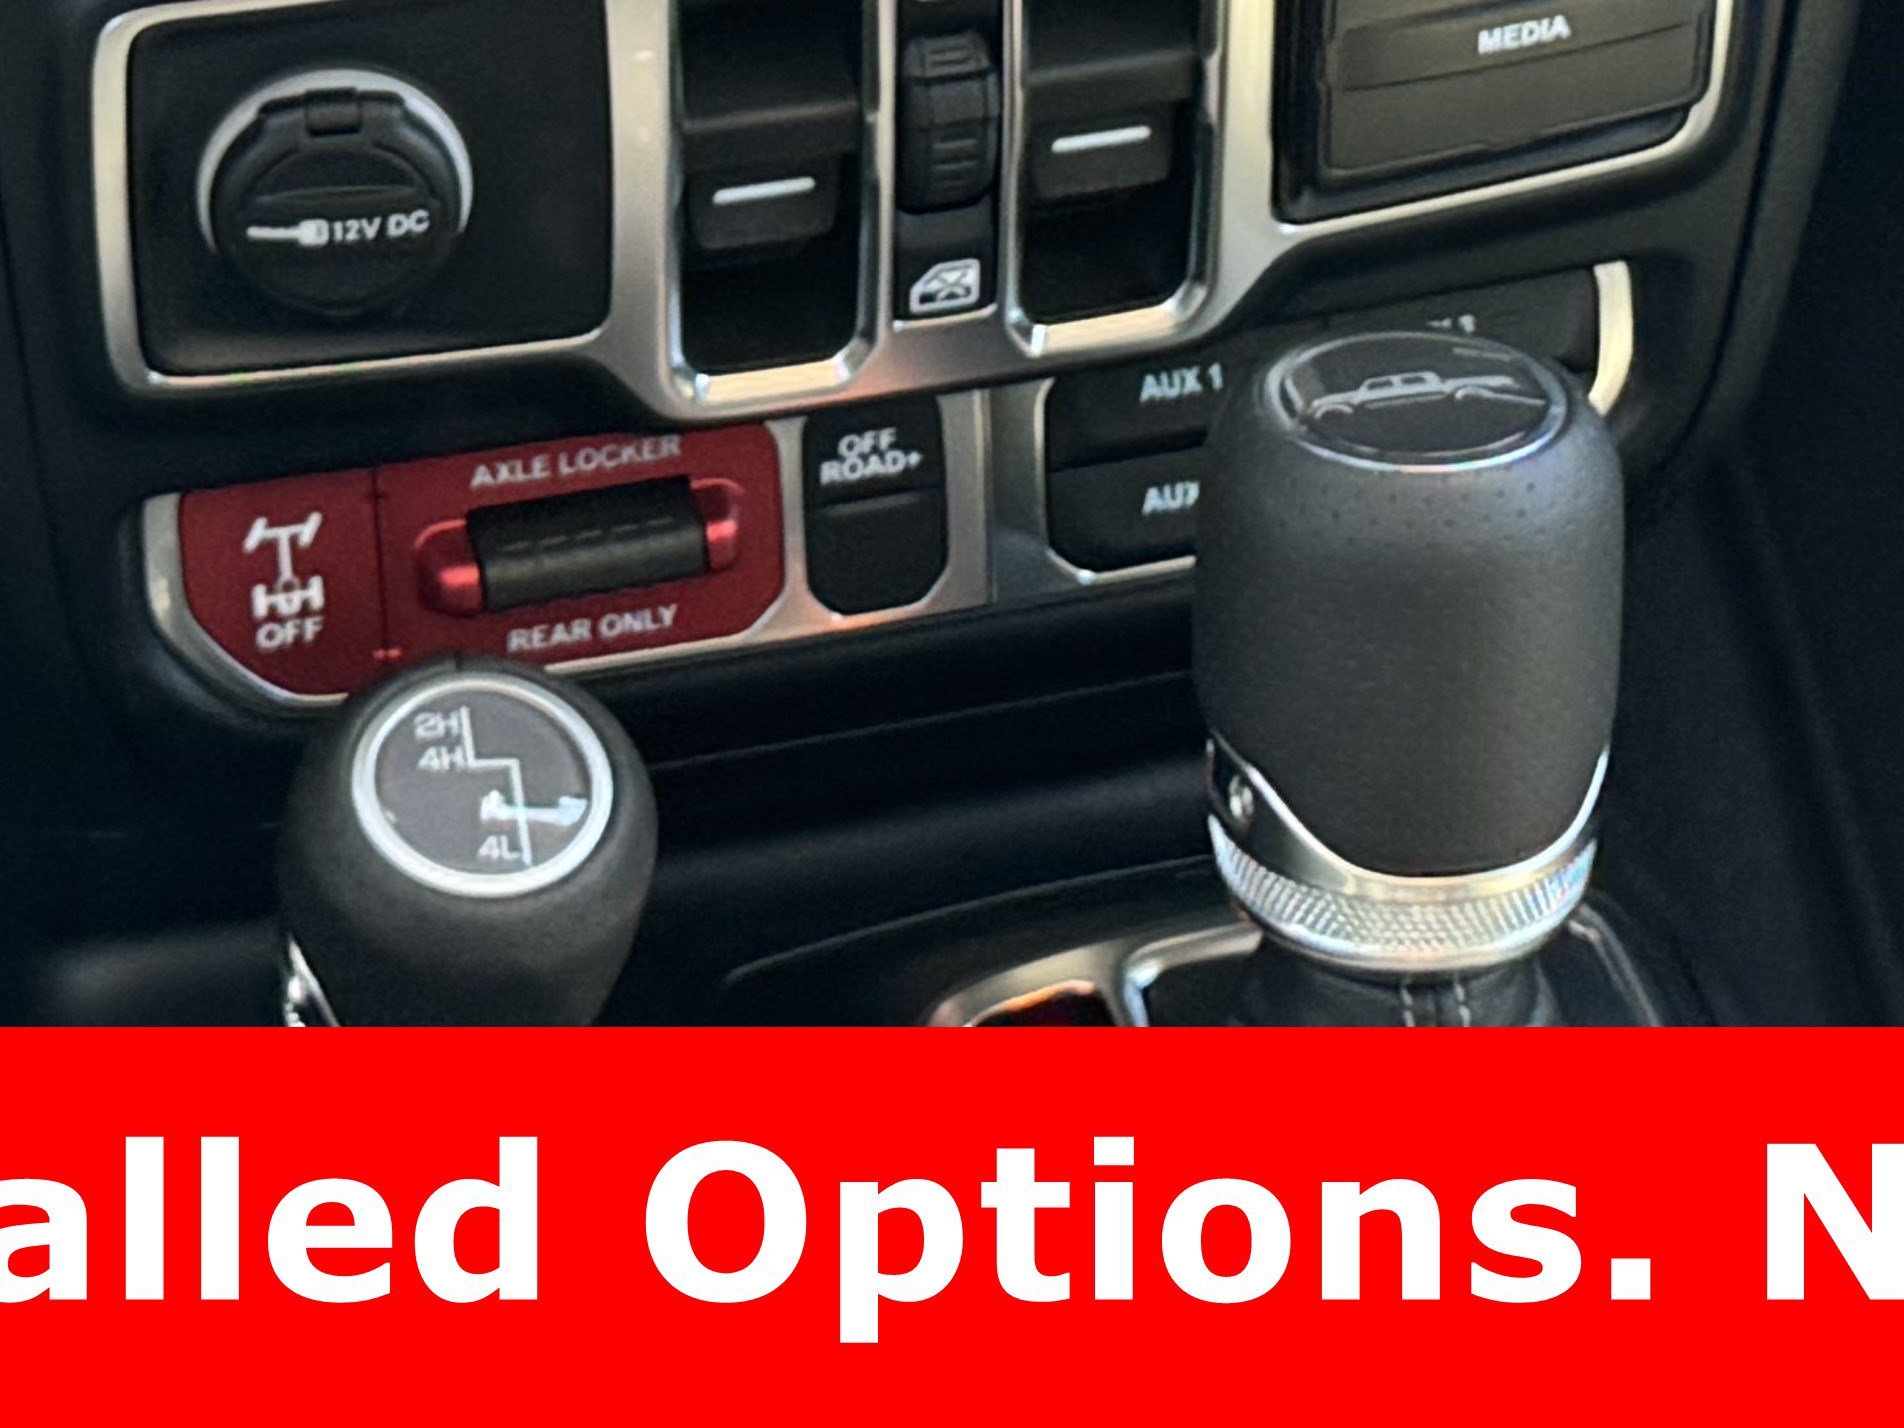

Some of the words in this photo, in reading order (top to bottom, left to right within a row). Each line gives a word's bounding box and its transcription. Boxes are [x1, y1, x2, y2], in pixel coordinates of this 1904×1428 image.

[1478, 14, 1571, 54] MEDIA
[332, 214, 381, 242] 12V
[387, 209, 430, 239] DC
[1139, 366, 1203, 404] AUX
[1208, 363, 1223, 391] 1
[838, 428, 896, 458] OFF
[470, 456, 551, 488] AXLE
[558, 435, 682, 475] LOCKER
[256, 616, 324, 651] OFF
[507, 619, 592, 652] REAR
[599, 603, 678, 637] ONLY
[413, 711, 462, 741] 2H
[416, 745, 468, 772] 4H
[477, 835, 521, 860] 4L
